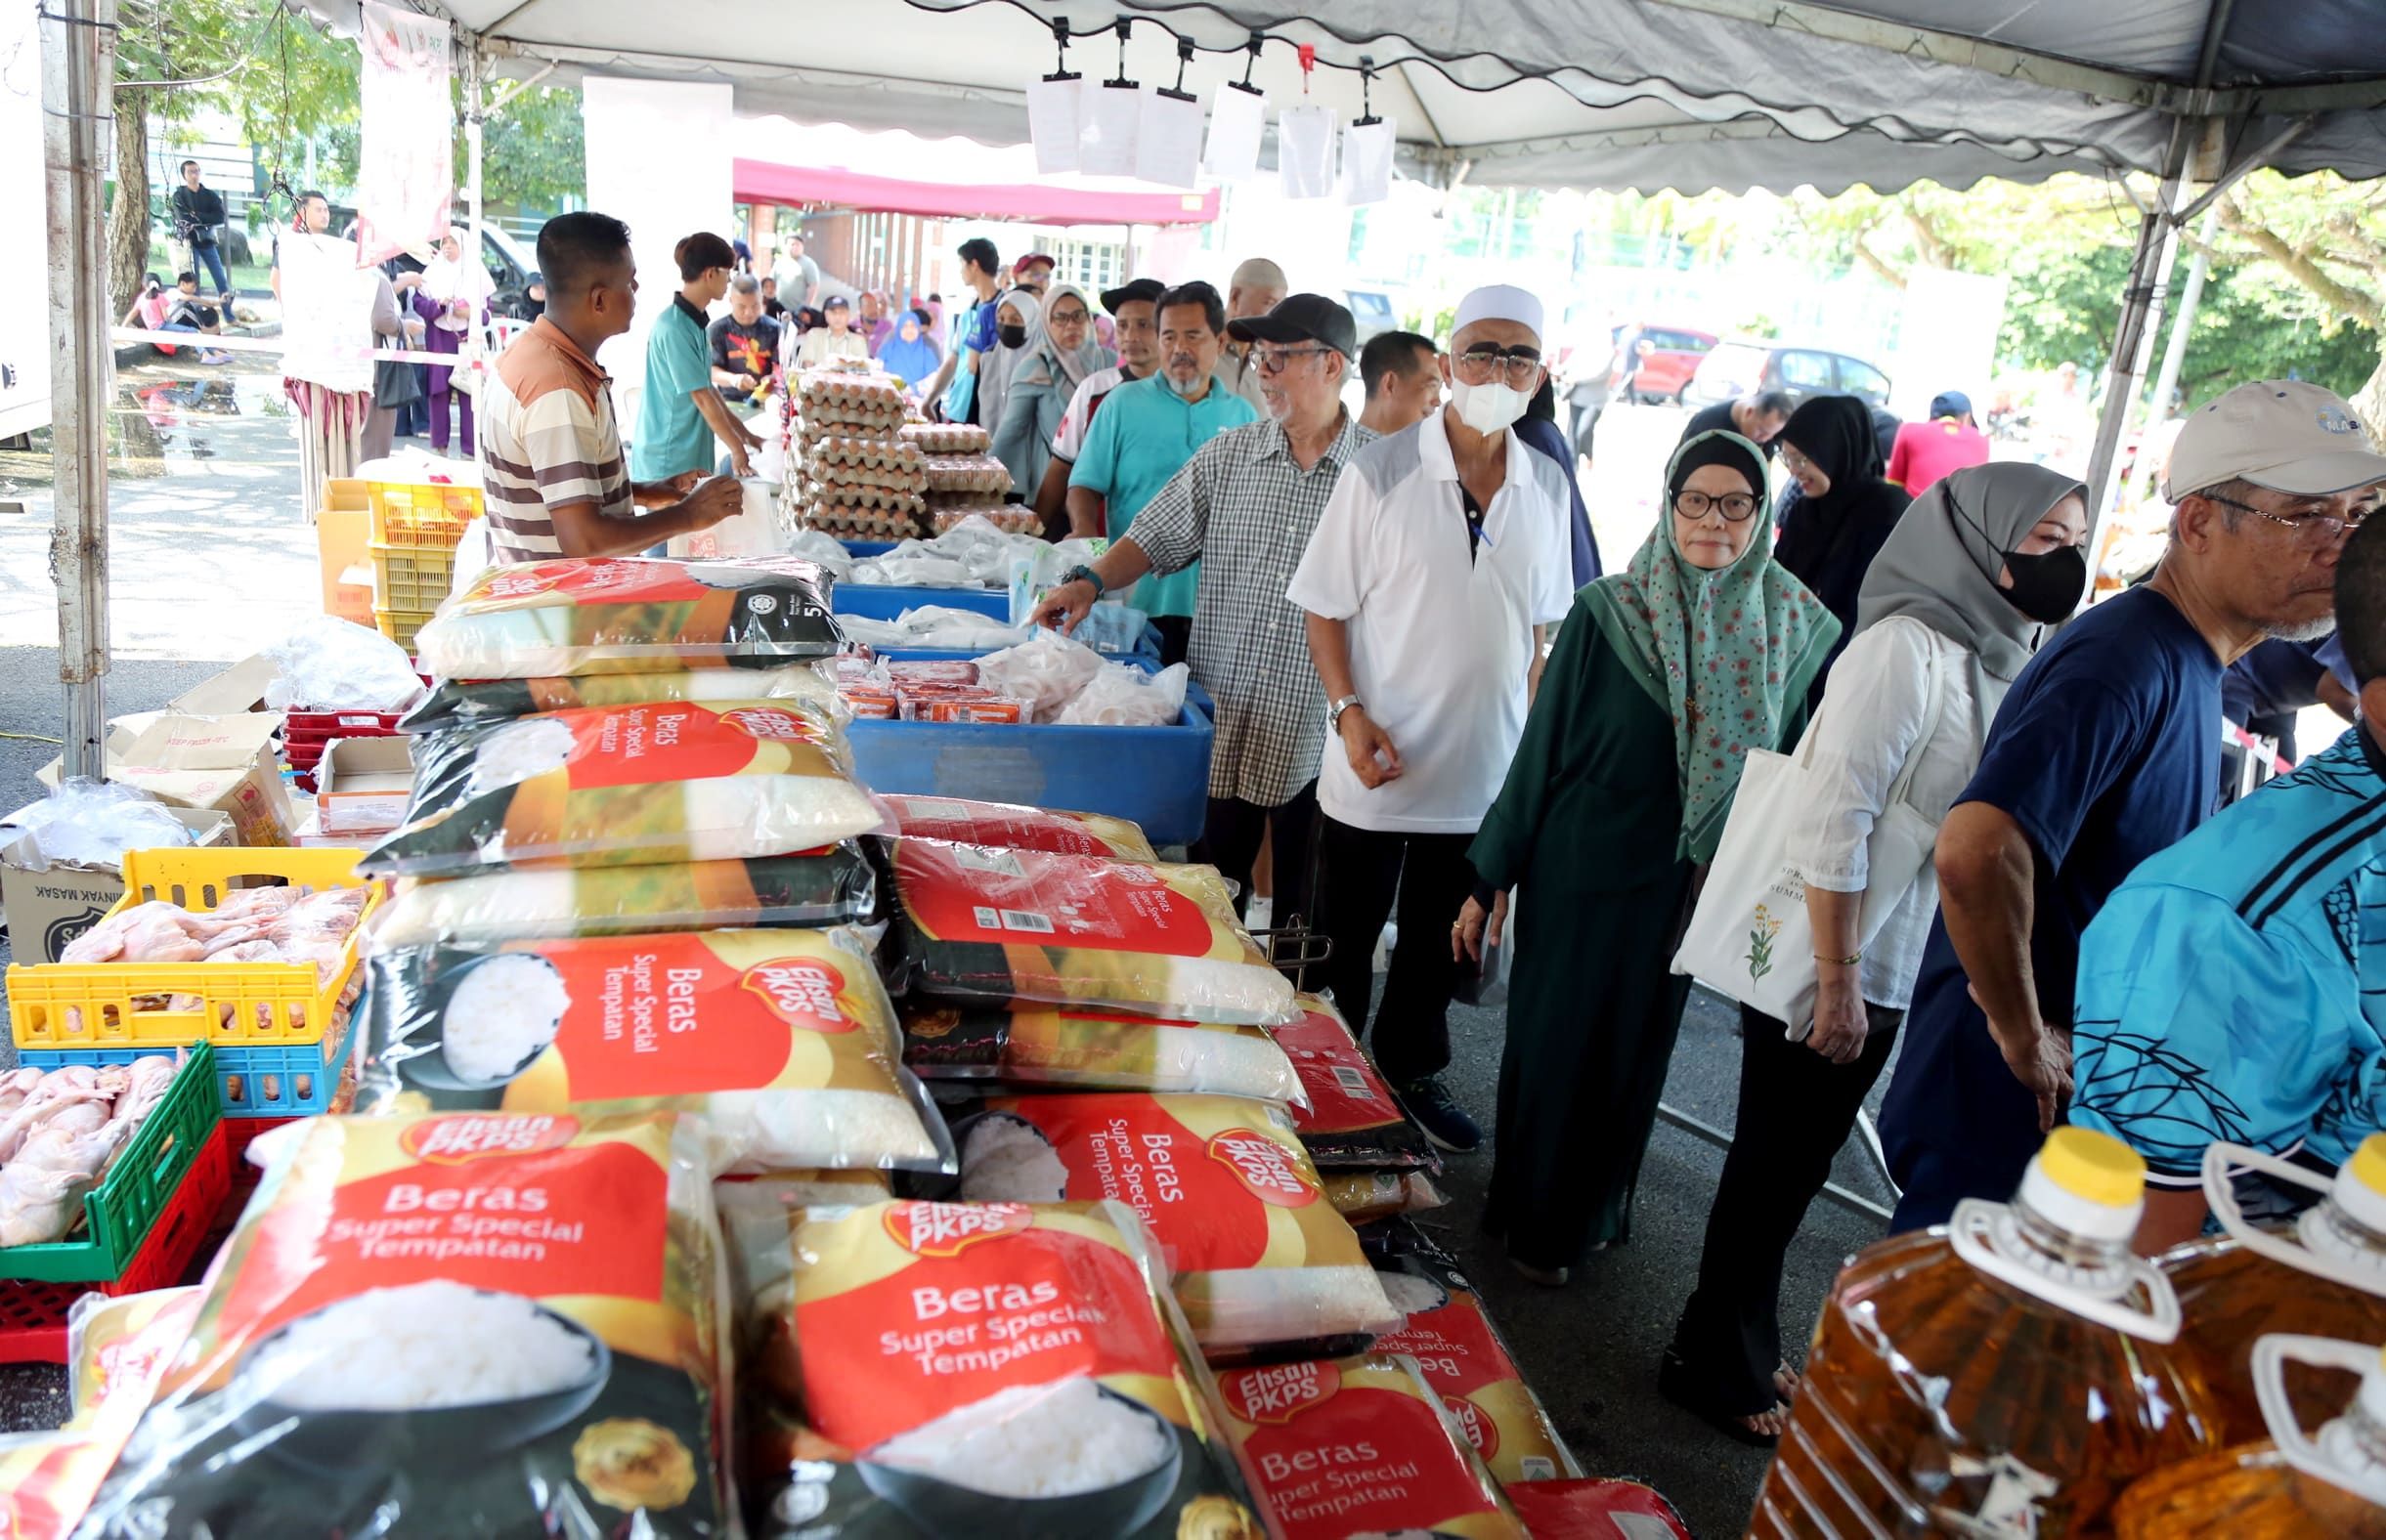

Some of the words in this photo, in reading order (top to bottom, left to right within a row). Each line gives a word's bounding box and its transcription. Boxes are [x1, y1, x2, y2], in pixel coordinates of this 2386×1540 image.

[655, 713, 688, 746] Beras
[35, 885, 78, 901] MASAK
[1151, 890, 1173, 913] Beras
[1147, 906, 1169, 929] Special
[627, 954, 658, 994] Super
[752, 965, 814, 1012] PKPS
[788, 965, 843, 1022] Ehsan
[597, 964, 629, 1041] Tempatan
[667, 967, 703, 1033] Beras
[627, 995, 660, 1053] Special
[416, 1132, 535, 1158] PKPS
[1107, 1118, 1135, 1160] Super
[1089, 1131, 1121, 1200] Tempata
[1141, 1134, 1185, 1203] Beras
[1213, 1137, 1279, 1187] PKPS
[1243, 1139, 1304, 1193] Ehsan
[383, 1183, 549, 1214] Beras
[1119, 1163, 1158, 1227] Special
[327, 1218, 443, 1243] Super
[450, 1212, 584, 1244] Special
[910, 1211, 1005, 1252] PKPS
[358, 1237, 546, 1262] Tempatan
[910, 1279, 1060, 1321] Beras
[880, 1321, 978, 1356] Super
[985, 1304, 1106, 1342] Special
[914, 1326, 1084, 1376] Tempatan
[1417, 1341, 1469, 1355] Super
[1238, 1361, 1319, 1398] Ehsan
[1245, 1377, 1321, 1421] PKPS
[1260, 1440, 1379, 1483] Beras
[1325, 1462, 1419, 1490] Special
[1276, 1483, 1409, 1522] Tempatan
